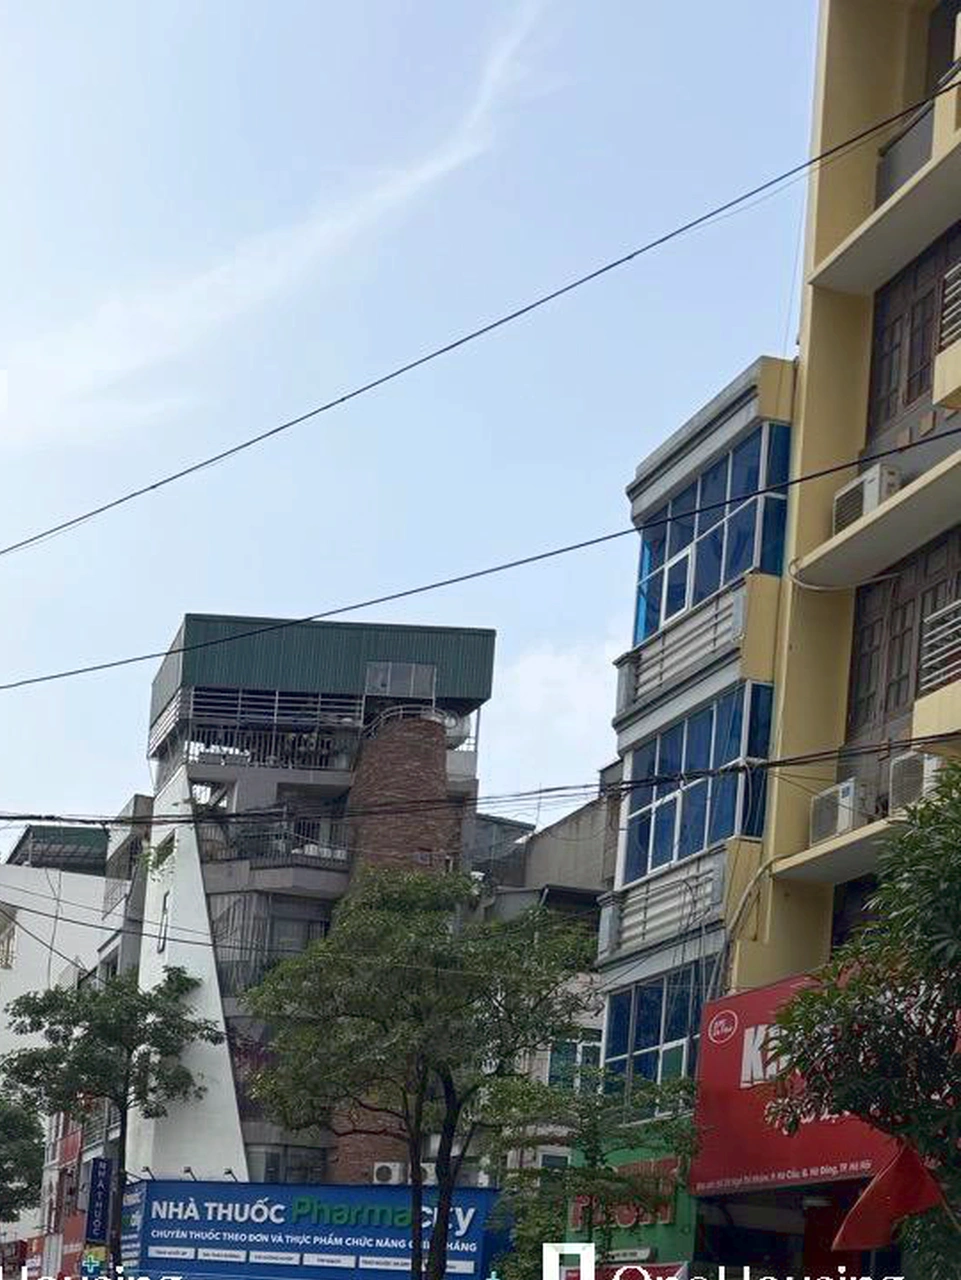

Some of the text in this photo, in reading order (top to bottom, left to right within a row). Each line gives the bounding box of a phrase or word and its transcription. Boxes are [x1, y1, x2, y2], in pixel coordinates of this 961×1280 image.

[151, 1195, 476, 1237] NHÀ THUỐC Pharmaciy
[190, 1229, 221, 1241] THUỐC
[223, 1231, 248, 1243] THEO
[344, 1235, 374, 1248] CHỨC
